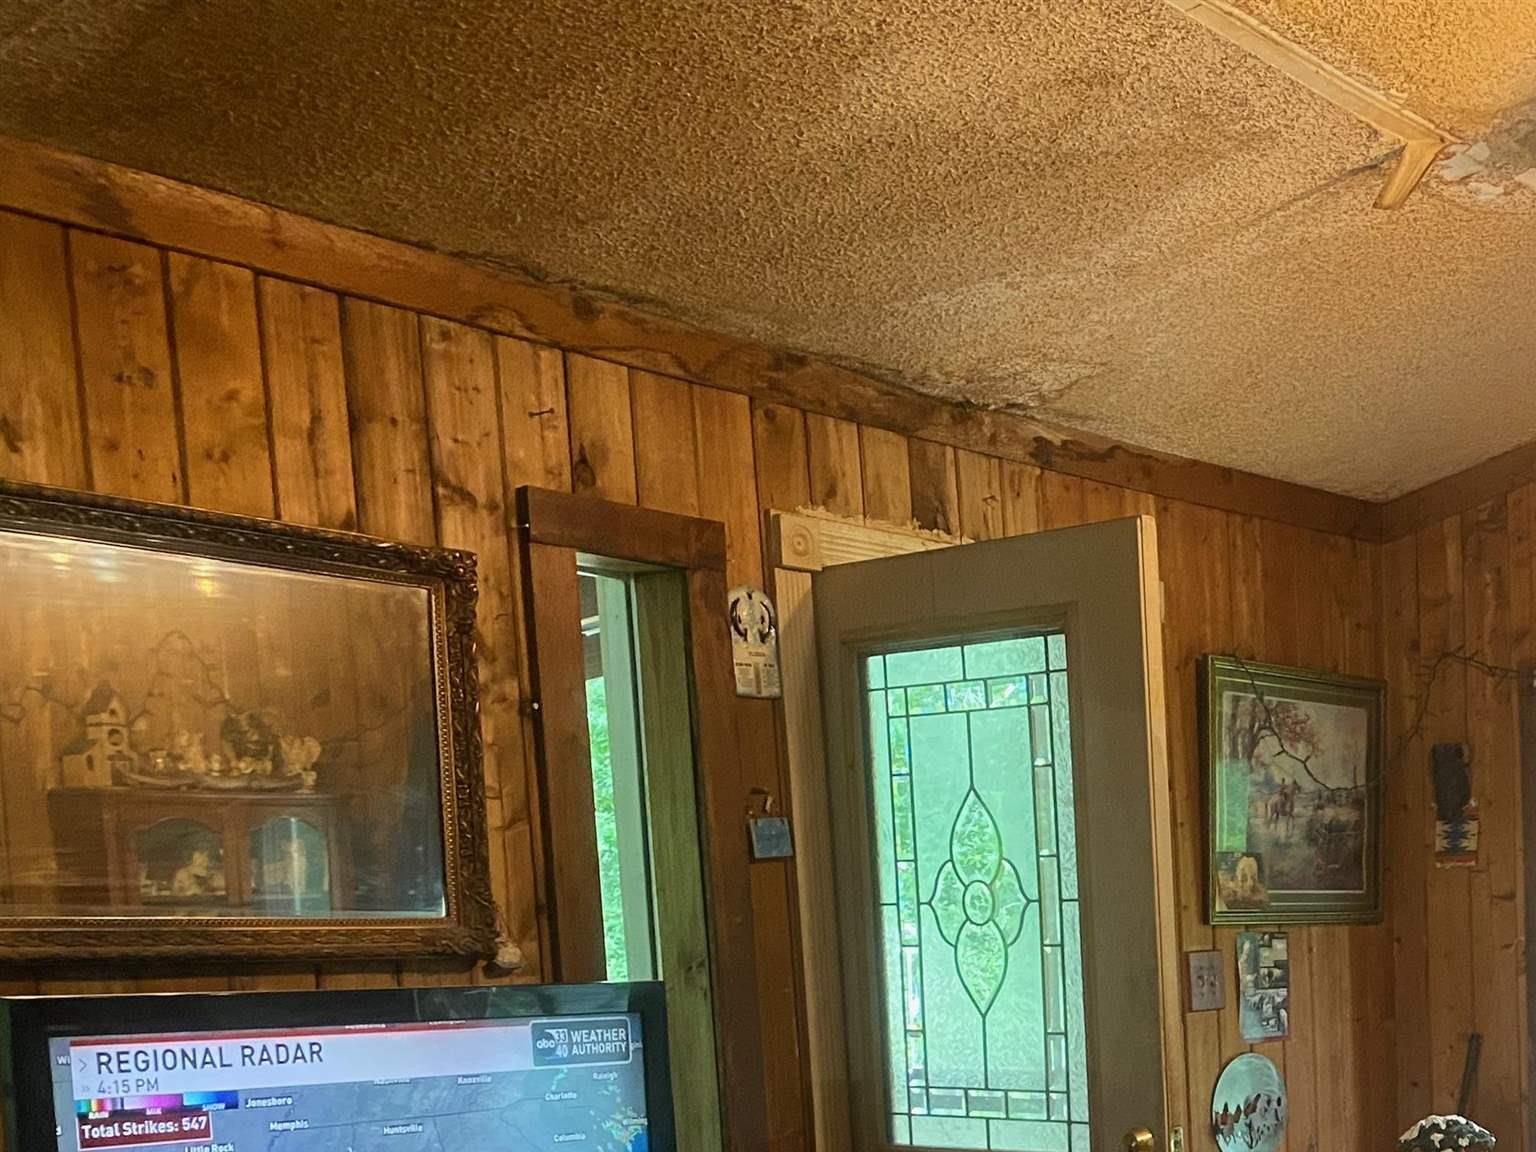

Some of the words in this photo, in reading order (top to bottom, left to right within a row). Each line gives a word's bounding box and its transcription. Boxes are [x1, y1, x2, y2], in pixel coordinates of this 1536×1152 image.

[571, 1028, 627, 1042] WEATHER
[555, 1044, 568, 1058] 40
[571, 1042, 627, 1056] AUTHORITY
[96, 1046, 233, 1075] REGIONAL
[241, 1041, 324, 1067] RADAR
[97, 1079, 130, 1094] 4:15
[136, 1077, 159, 1092] PM
[245, 1096, 293, 1108] Jonesboro
[81, 1122, 120, 1139] Total
[122, 1120, 179, 1136] Strikes:
[182, 1116, 208, 1131] 547
[269, 1119, 310, 1131] Memphis
[383, 1124, 423, 1135] Huntsville
[211, 1143, 234, 1152] Rock
